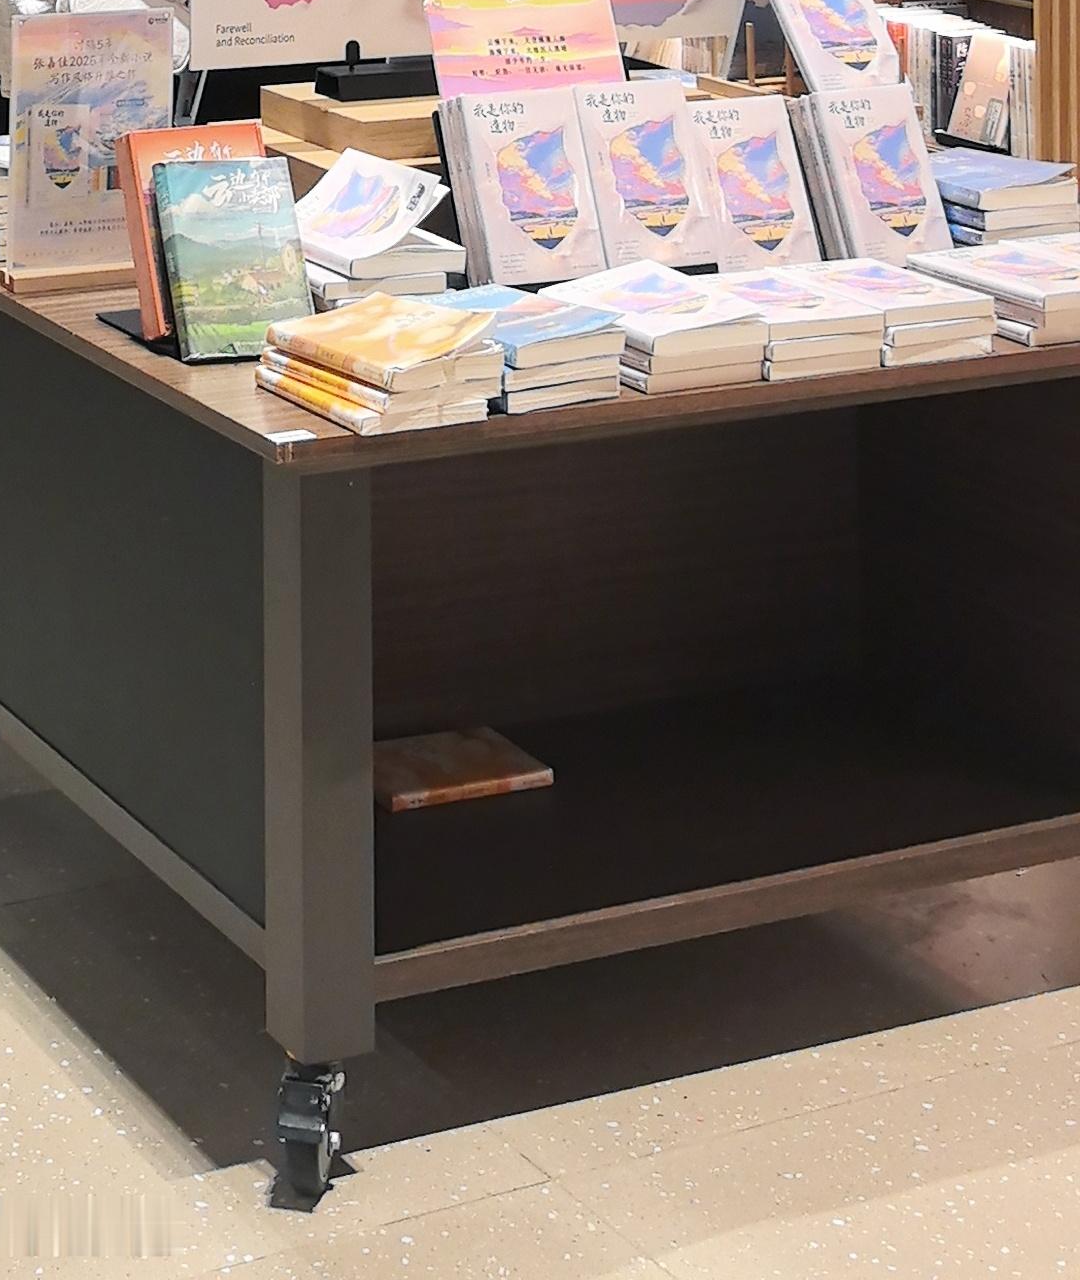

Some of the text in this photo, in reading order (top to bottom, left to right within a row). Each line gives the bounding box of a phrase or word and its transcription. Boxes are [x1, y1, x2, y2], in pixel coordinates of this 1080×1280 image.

[216, 22, 252, 34] Farewell
[216, 33, 295, 47] and Reconciliation
[585, 92, 635, 108] 我是你的
[828, 99, 872, 115] 我是你的
[473, 102, 525, 118] 我是你的
[602, 109, 626, 123] 遗物
[693, 108, 740, 125] 我是你的
[490, 120, 515, 134] 遗物
